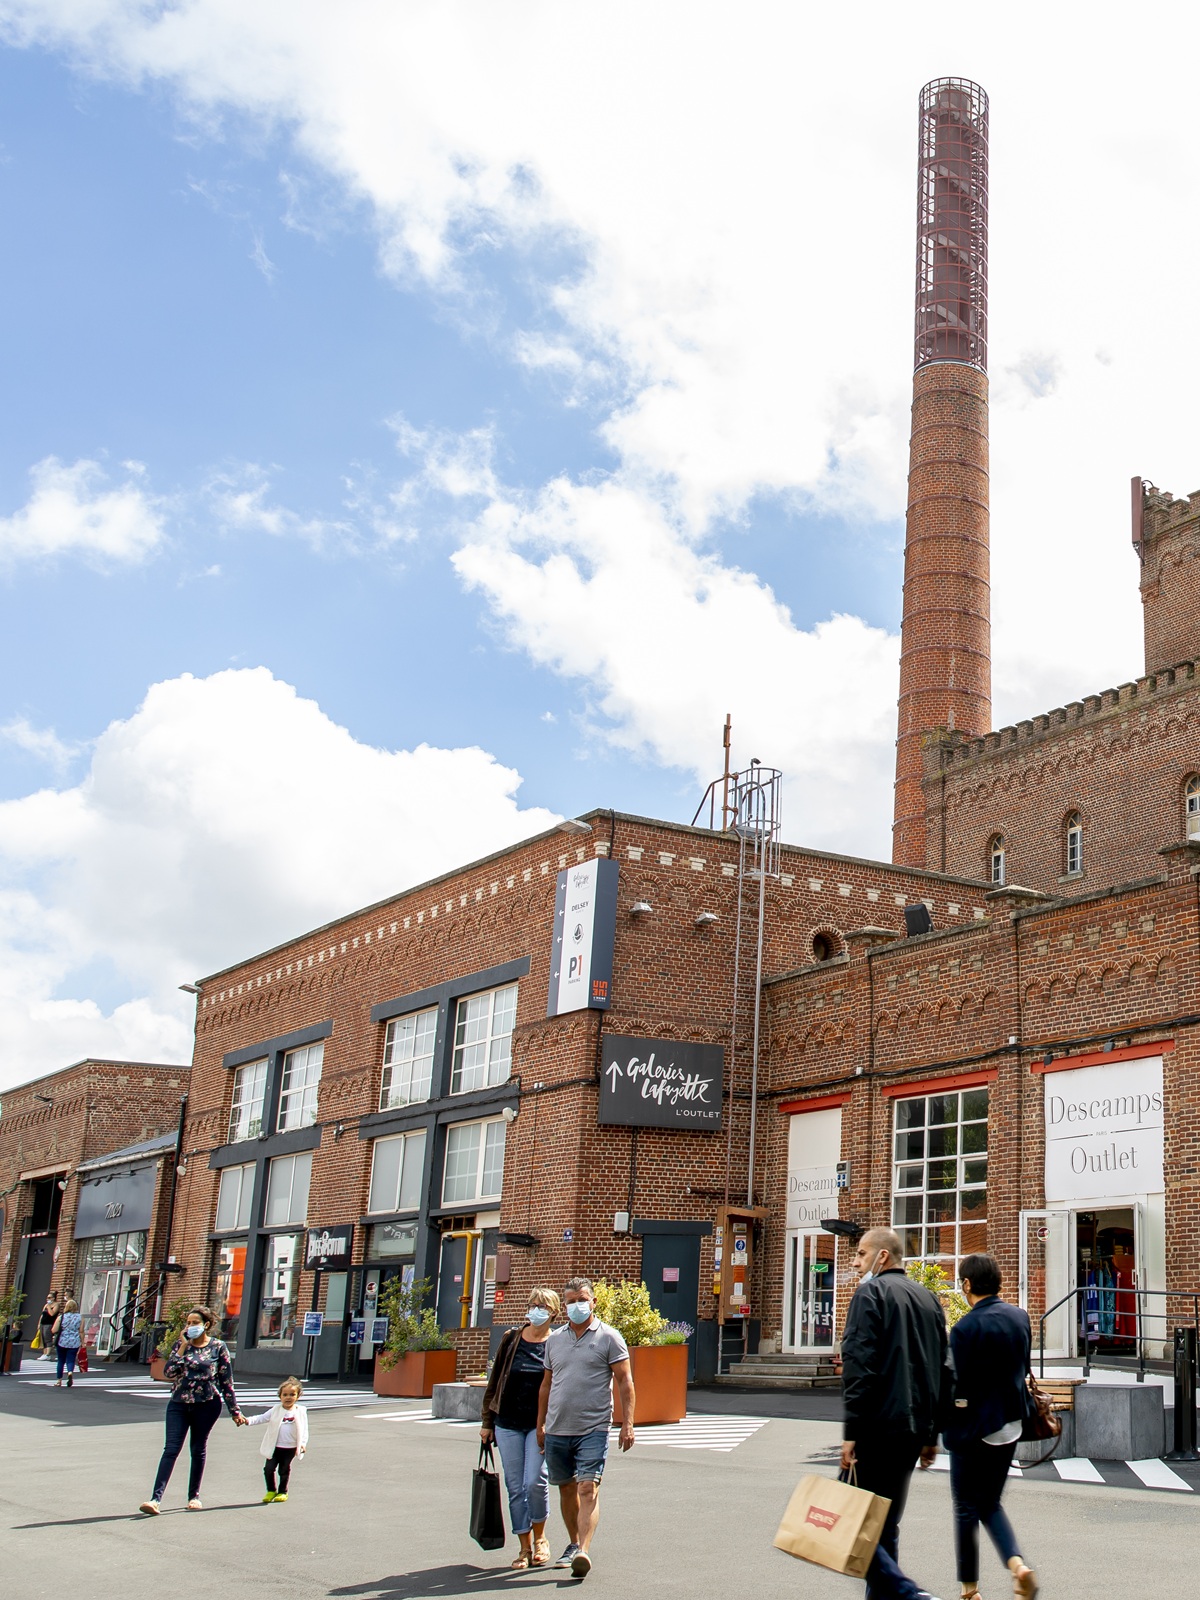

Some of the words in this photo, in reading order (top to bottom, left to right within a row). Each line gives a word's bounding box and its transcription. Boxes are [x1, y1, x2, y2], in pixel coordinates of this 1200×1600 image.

[571, 901, 589, 911] DELSEY
[568, 954, 583, 979] P1
[626, 1053, 685, 1083] Galeries
[641, 1073, 714, 1105] Lafayette
[676, 1109, 720, 1119] L'OUTLET
[1048, 1092, 1163, 1125] Descamps
[1071, 1142, 1139, 1174] Outlet
[789, 1176, 838, 1195] Descamp
[798, 1204, 830, 1222] Outlet
